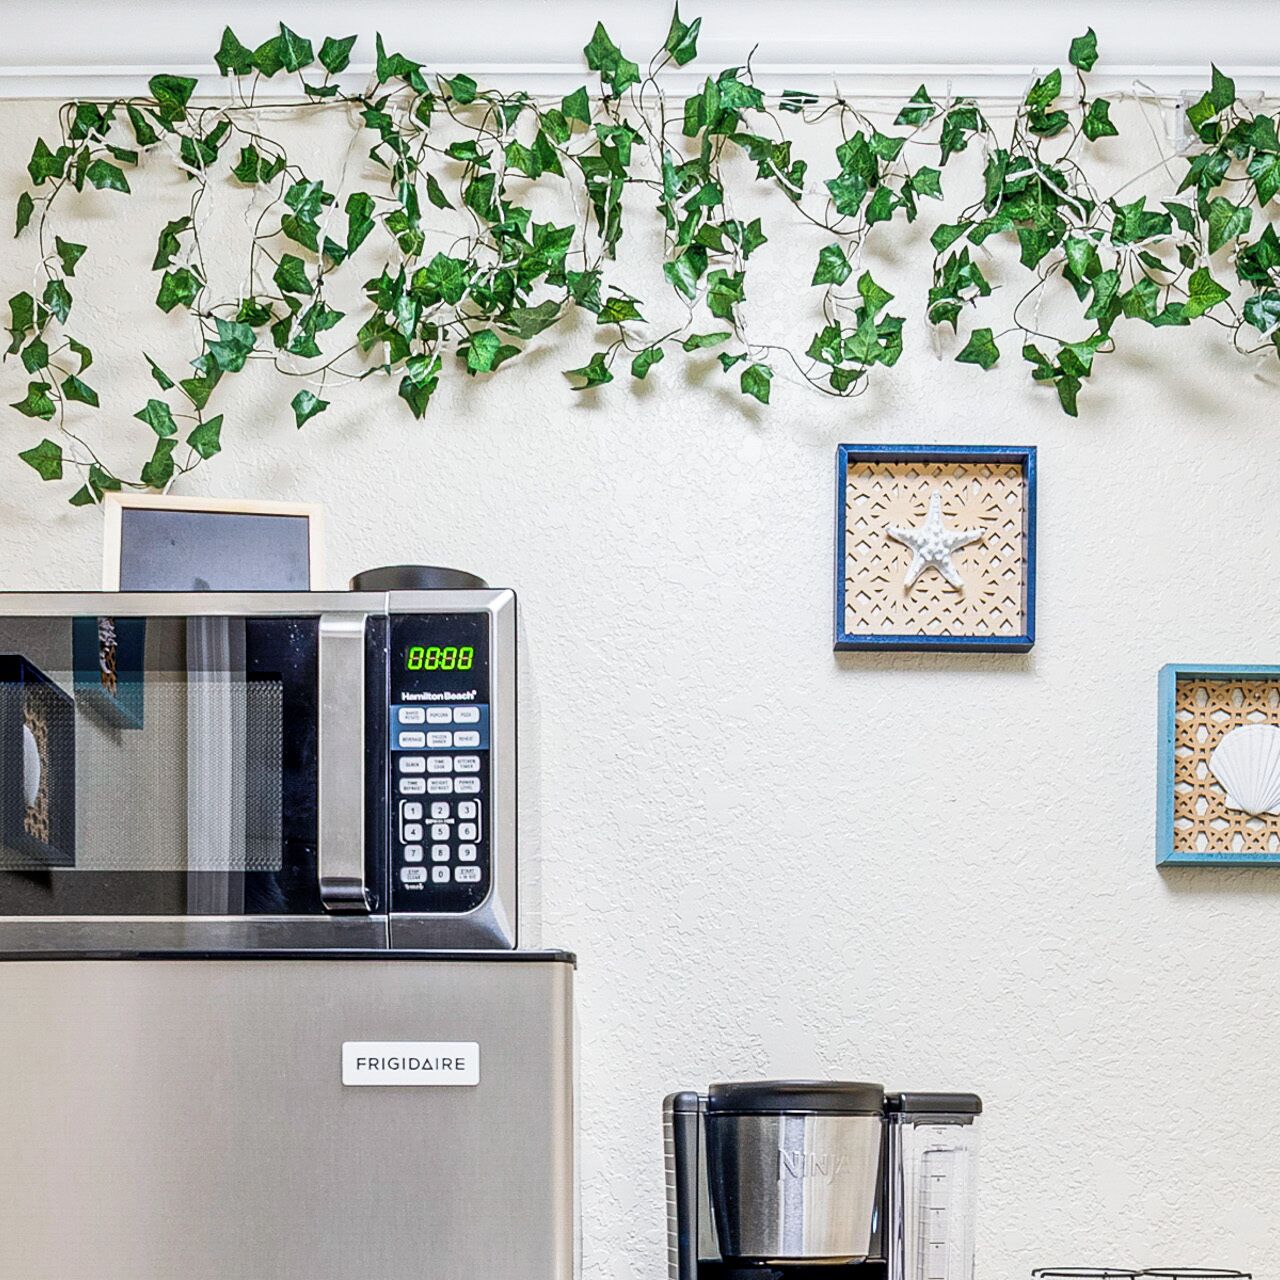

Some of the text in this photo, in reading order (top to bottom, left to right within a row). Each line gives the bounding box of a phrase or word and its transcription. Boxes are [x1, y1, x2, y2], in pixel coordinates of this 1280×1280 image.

[401, 691, 443, 701] Hamilton
[437, 807, 443, 815] 2
[464, 806, 470, 814] 3
[410, 828, 416, 836] 4
[437, 828, 443, 836] 5
[464, 827, 470, 835] 6
[411, 849, 416, 857] 7
[438, 849, 443, 857] 8
[464, 849, 470, 857] 9
[355, 1057, 466, 1071] FRIGIDAIRE
